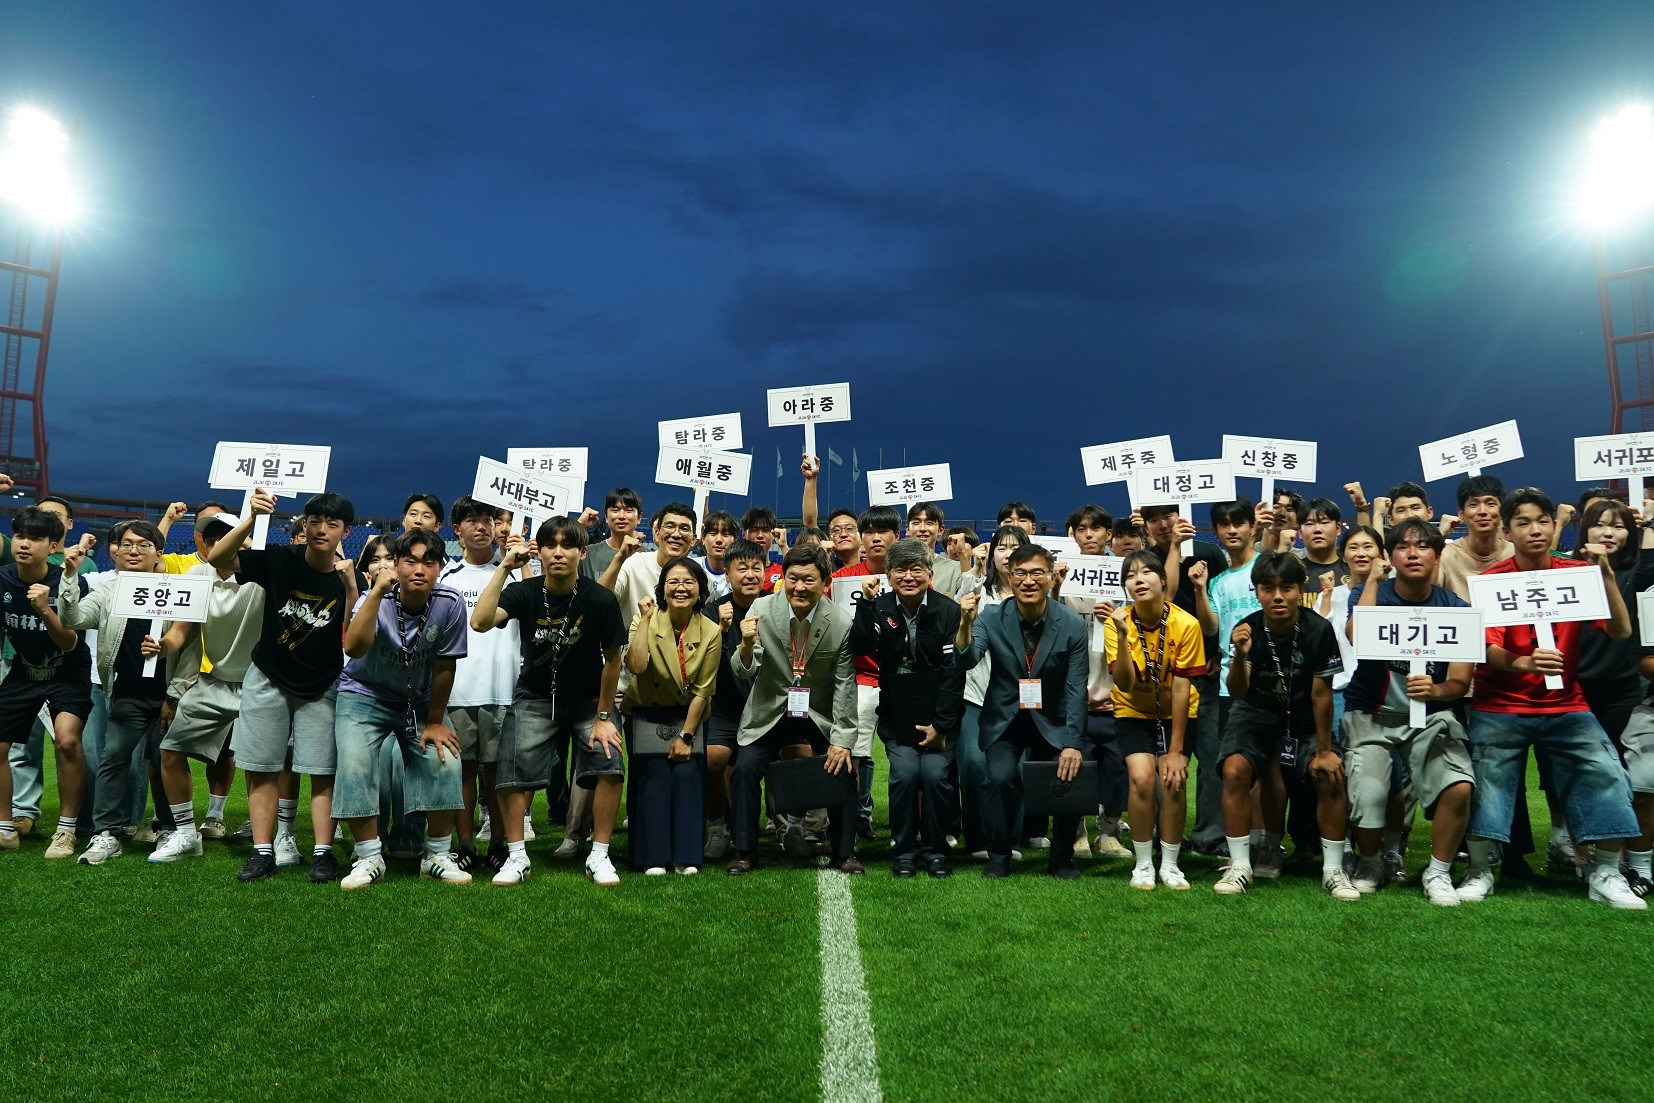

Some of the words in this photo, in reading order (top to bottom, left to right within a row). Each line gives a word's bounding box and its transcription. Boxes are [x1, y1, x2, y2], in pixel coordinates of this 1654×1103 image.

[783, 396, 834, 414] 아라중
[675, 426, 726, 445] 탐라중
[1101, 450, 1156, 472] 제주중
[1241, 450, 1298, 470] 신창중
[1441, 438, 1500, 466] 노형중
[236, 457, 305, 478] 제일고
[676, 458, 732, 481] 애월중
[885, 477, 935, 495] 조천중
[1153, 474, 1215, 493] 대정고
[490, 477, 556, 511] 사대부고
[1069, 568, 1120, 588] 서귀포
[133, 587, 192, 607] 중앙고
[1496, 586, 1580, 612] 남주고
[1378, 623, 1459, 646] 대기고
